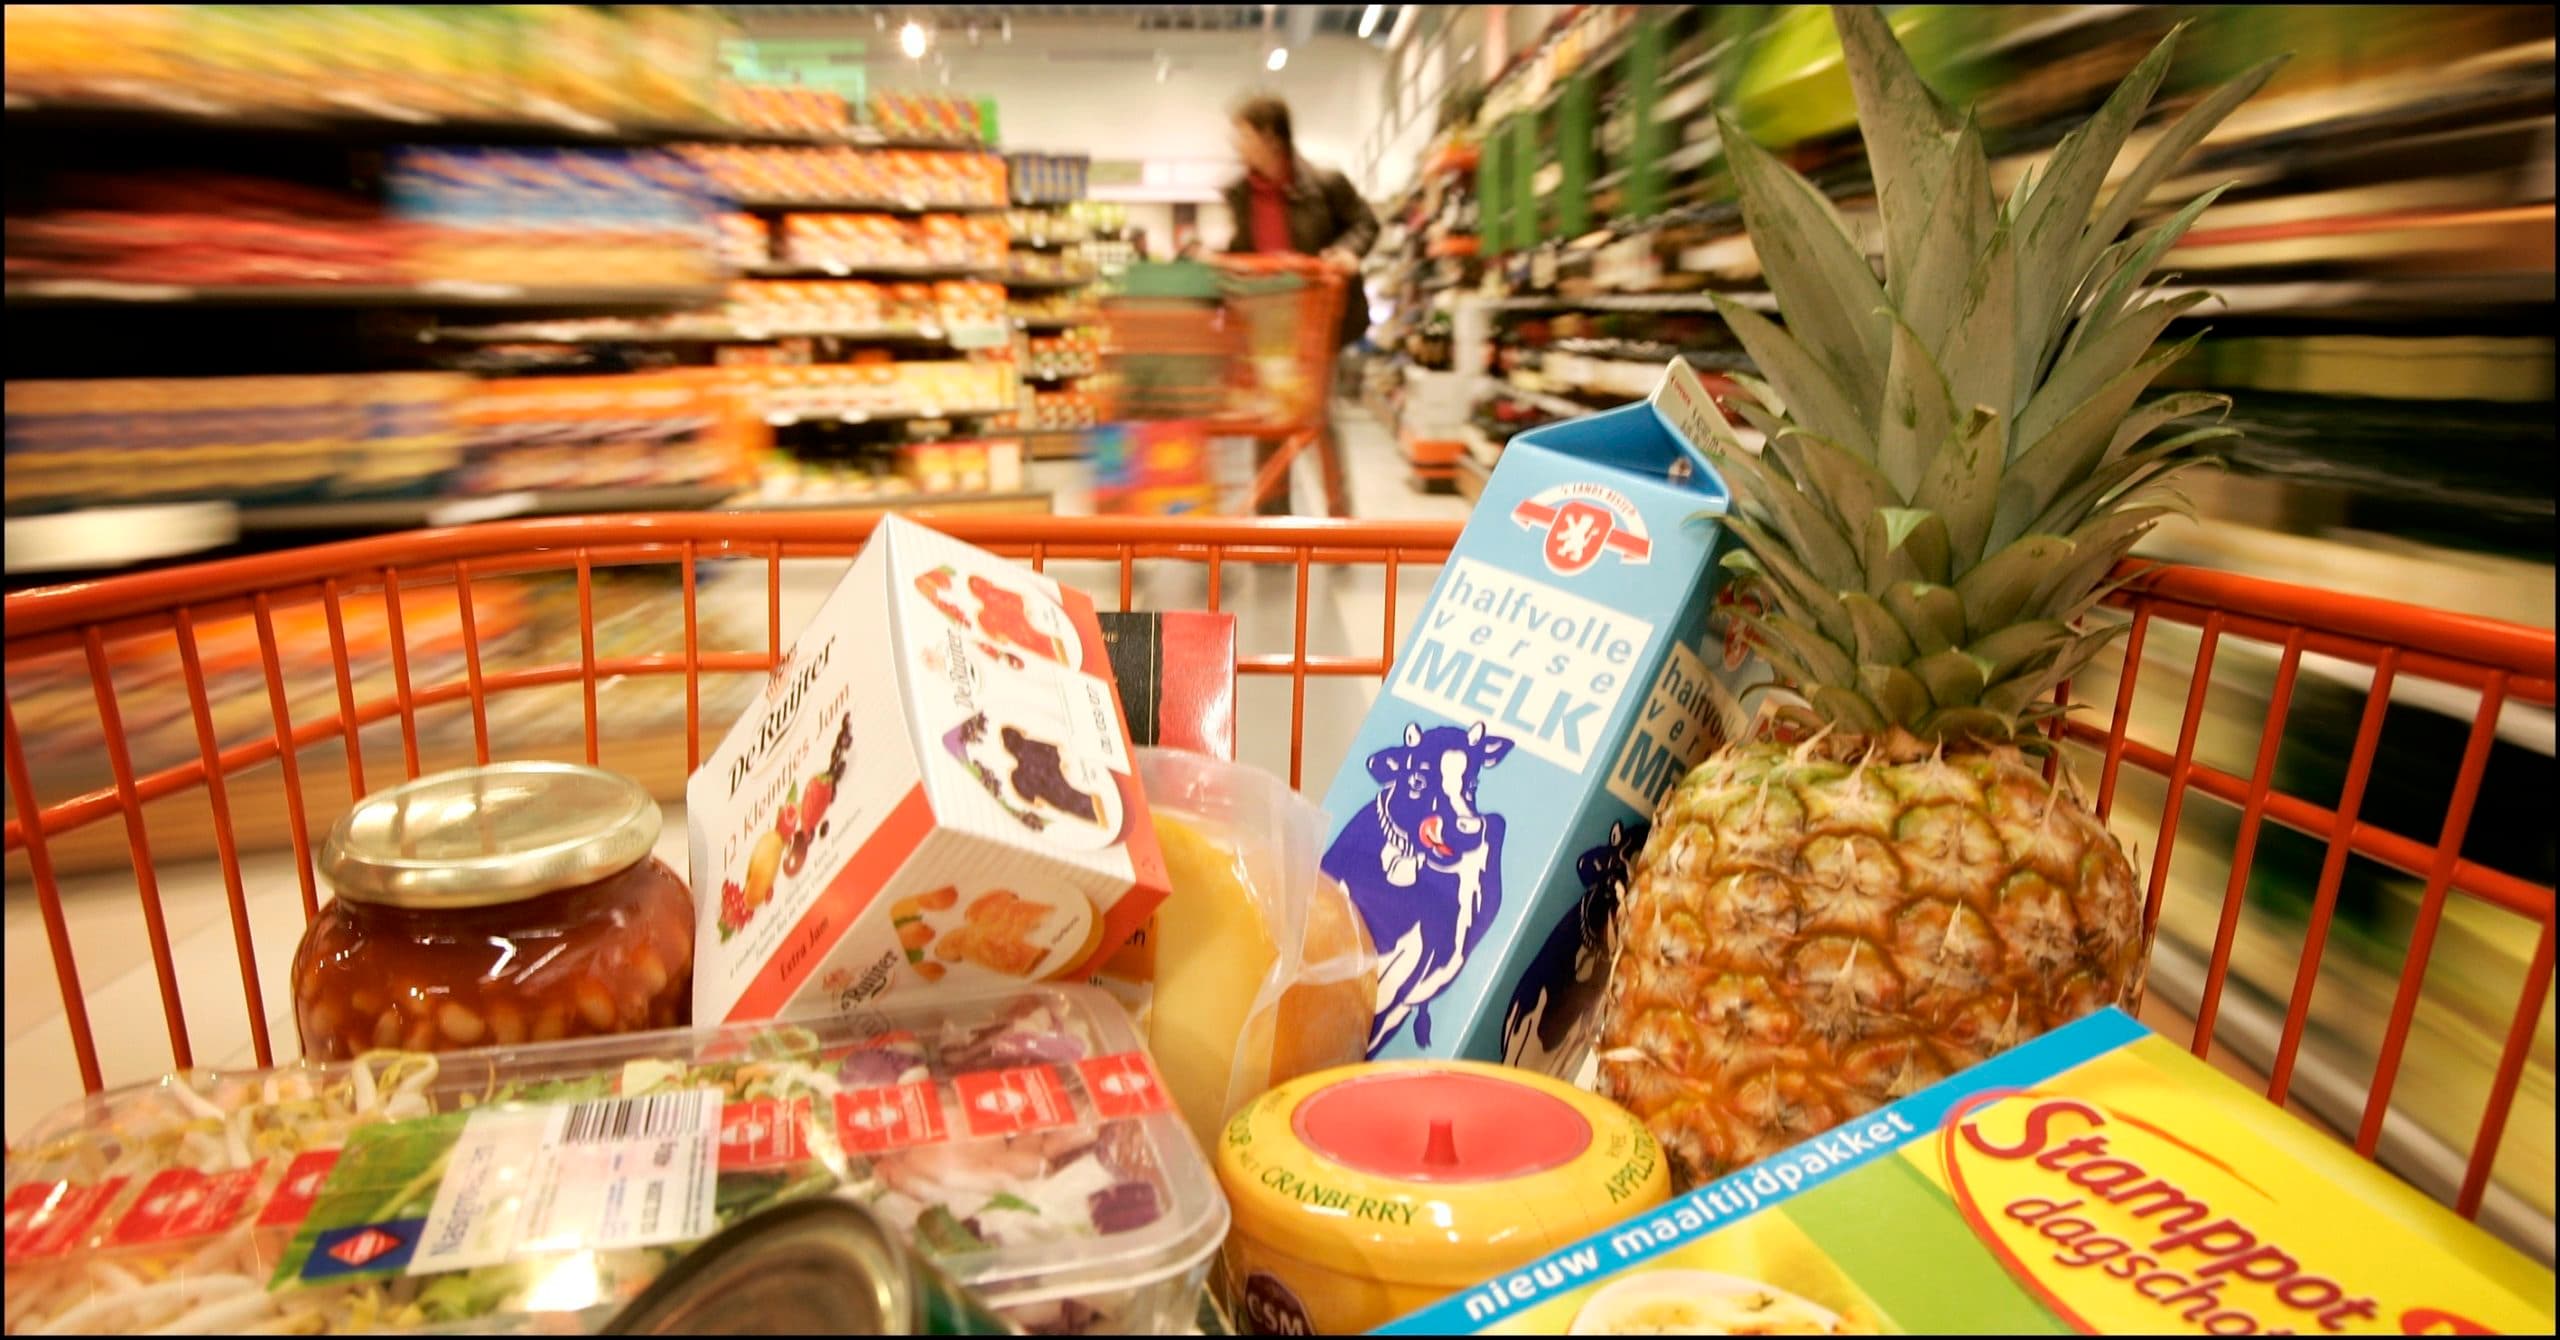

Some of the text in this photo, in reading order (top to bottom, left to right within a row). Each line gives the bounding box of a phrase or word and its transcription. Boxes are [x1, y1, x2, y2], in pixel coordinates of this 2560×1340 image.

[1448, 571, 1633, 665] halfvolle
[1406, 638, 1603, 756] MELK
[1646, 698, 1710, 757] ver
[1661, 656, 1734, 746] halfvoll
[723, 682, 850, 872] 12 Kleintjes Jam
[1619, 729, 1687, 804] ME
[780, 916, 830, 982] Extra Jam
[1260, 1167, 1419, 1226] CRANBERRY
[1464, 1110, 1916, 1322] nieuw maaltijdpakket
[1960, 1100, 2379, 1333] Stamppot
[2003, 1194, 2296, 1335] dagscho
[1247, 1294, 1305, 1335] CSM
